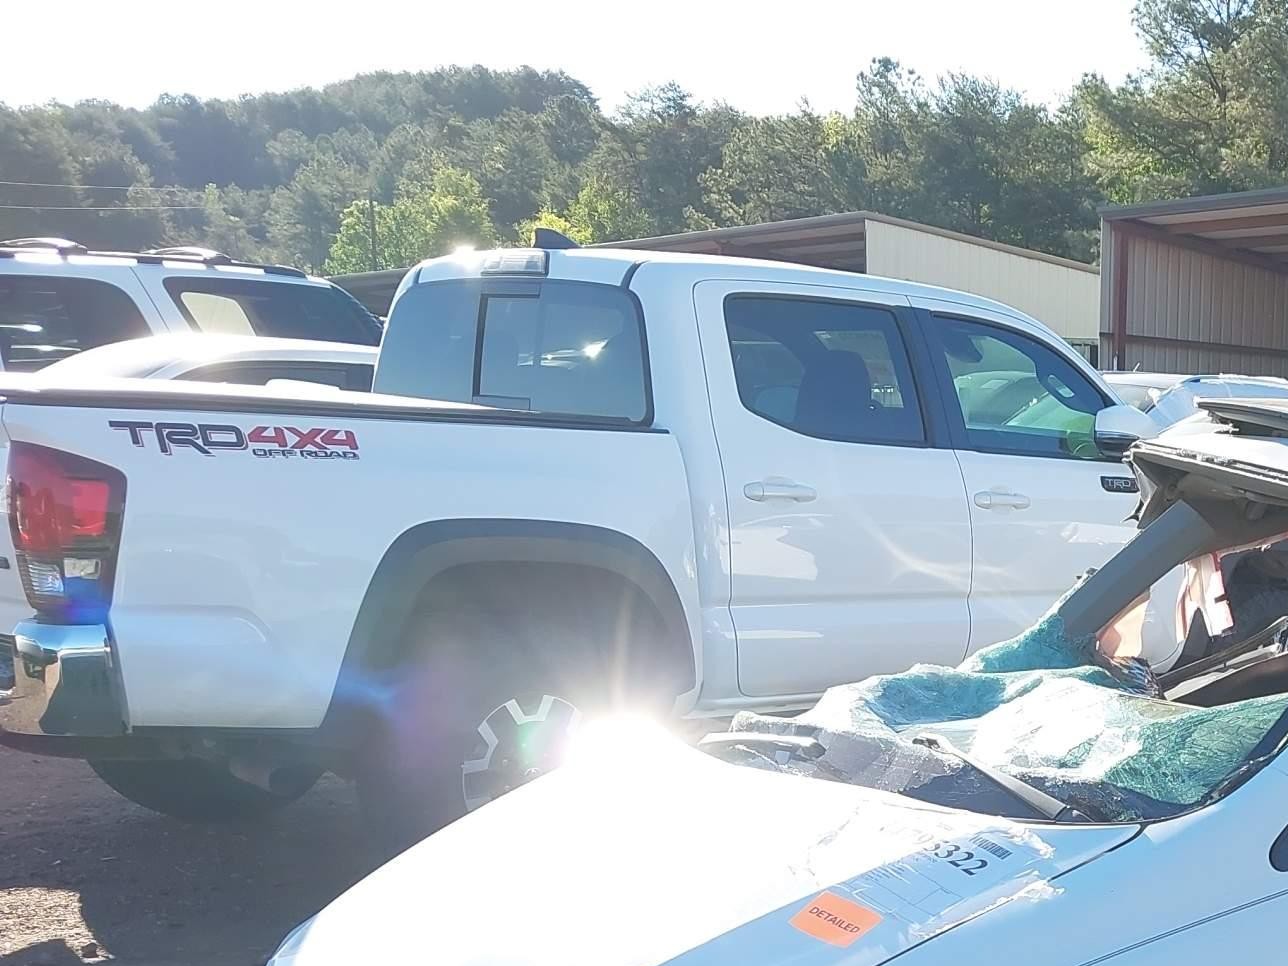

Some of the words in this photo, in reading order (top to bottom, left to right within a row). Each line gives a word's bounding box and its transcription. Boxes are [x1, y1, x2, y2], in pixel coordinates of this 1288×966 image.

[108, 420, 248, 457] TRD
[252, 448, 297, 459] OFF
[300, 449, 360, 461] ROAD
[1105, 479, 1131, 489] TRD
[808, 905, 861, 935] DETAILED
